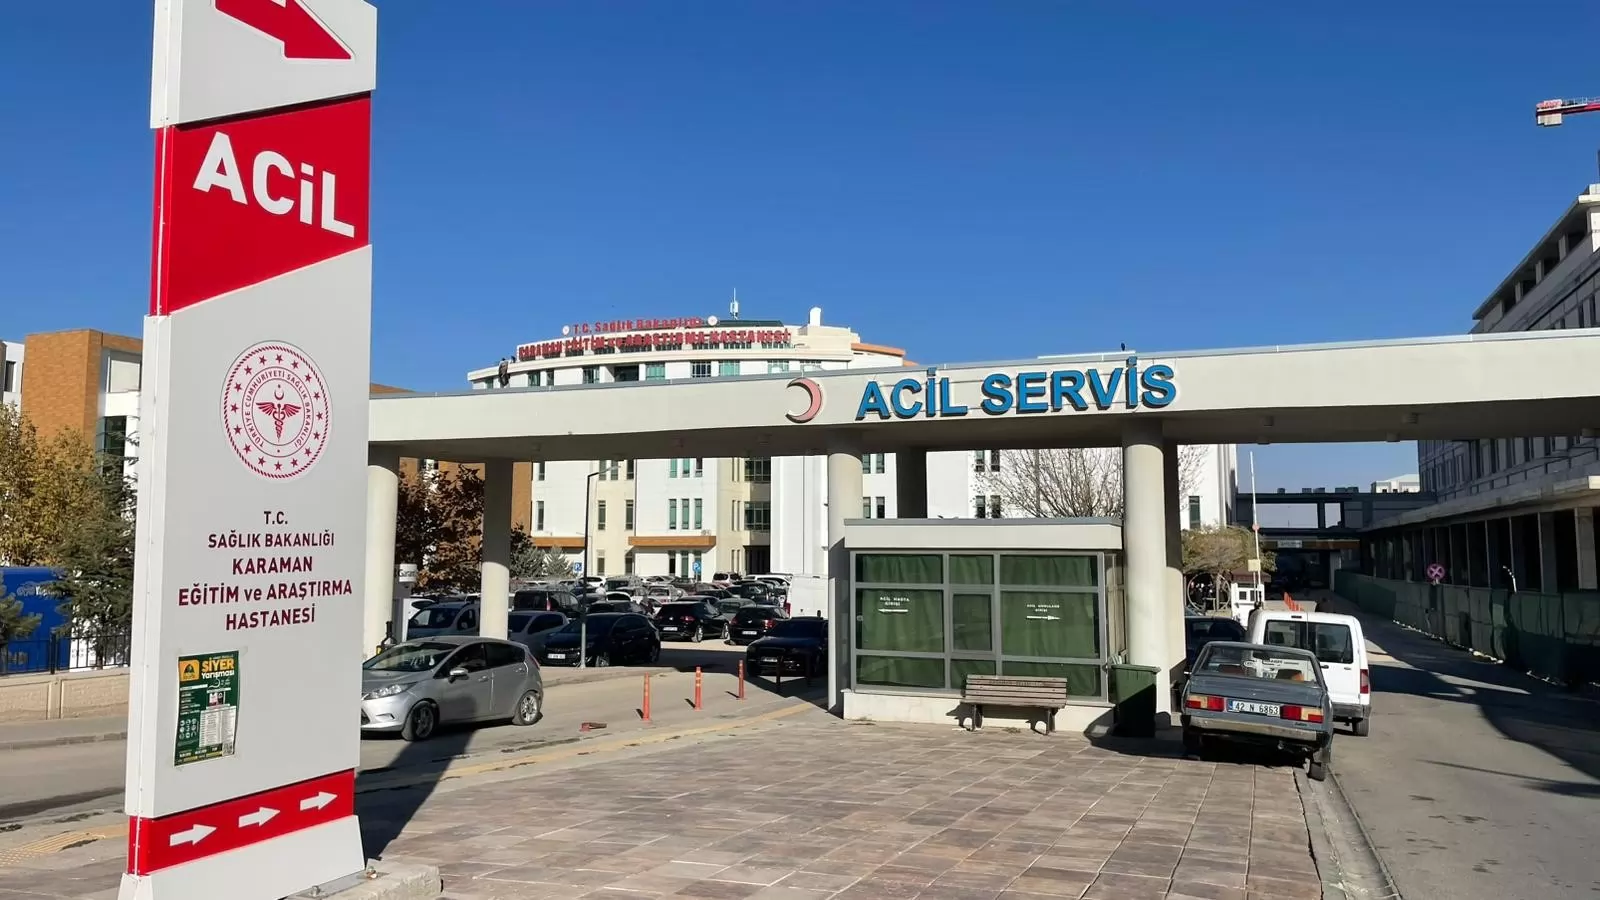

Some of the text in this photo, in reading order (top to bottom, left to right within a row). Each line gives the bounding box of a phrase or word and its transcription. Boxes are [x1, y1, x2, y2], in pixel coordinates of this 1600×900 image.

[245, 370, 285, 407] CUMHURİYETİ
[854, 356, 1177, 421] ACİL SERVİS
[264, 510, 288, 525] T.C.
[208, 529, 335, 548] SAĞLIK BAKANLIĞI
[232, 556, 313, 575] KARAMAN
[178, 579, 353, 606] EĞİTİM ve ARAŞTIRMA
[226, 603, 315, 630] HASTANESİ
[201, 656, 235, 672] SİYER
[1235, 702, 1279, 715] 42 N 6863
